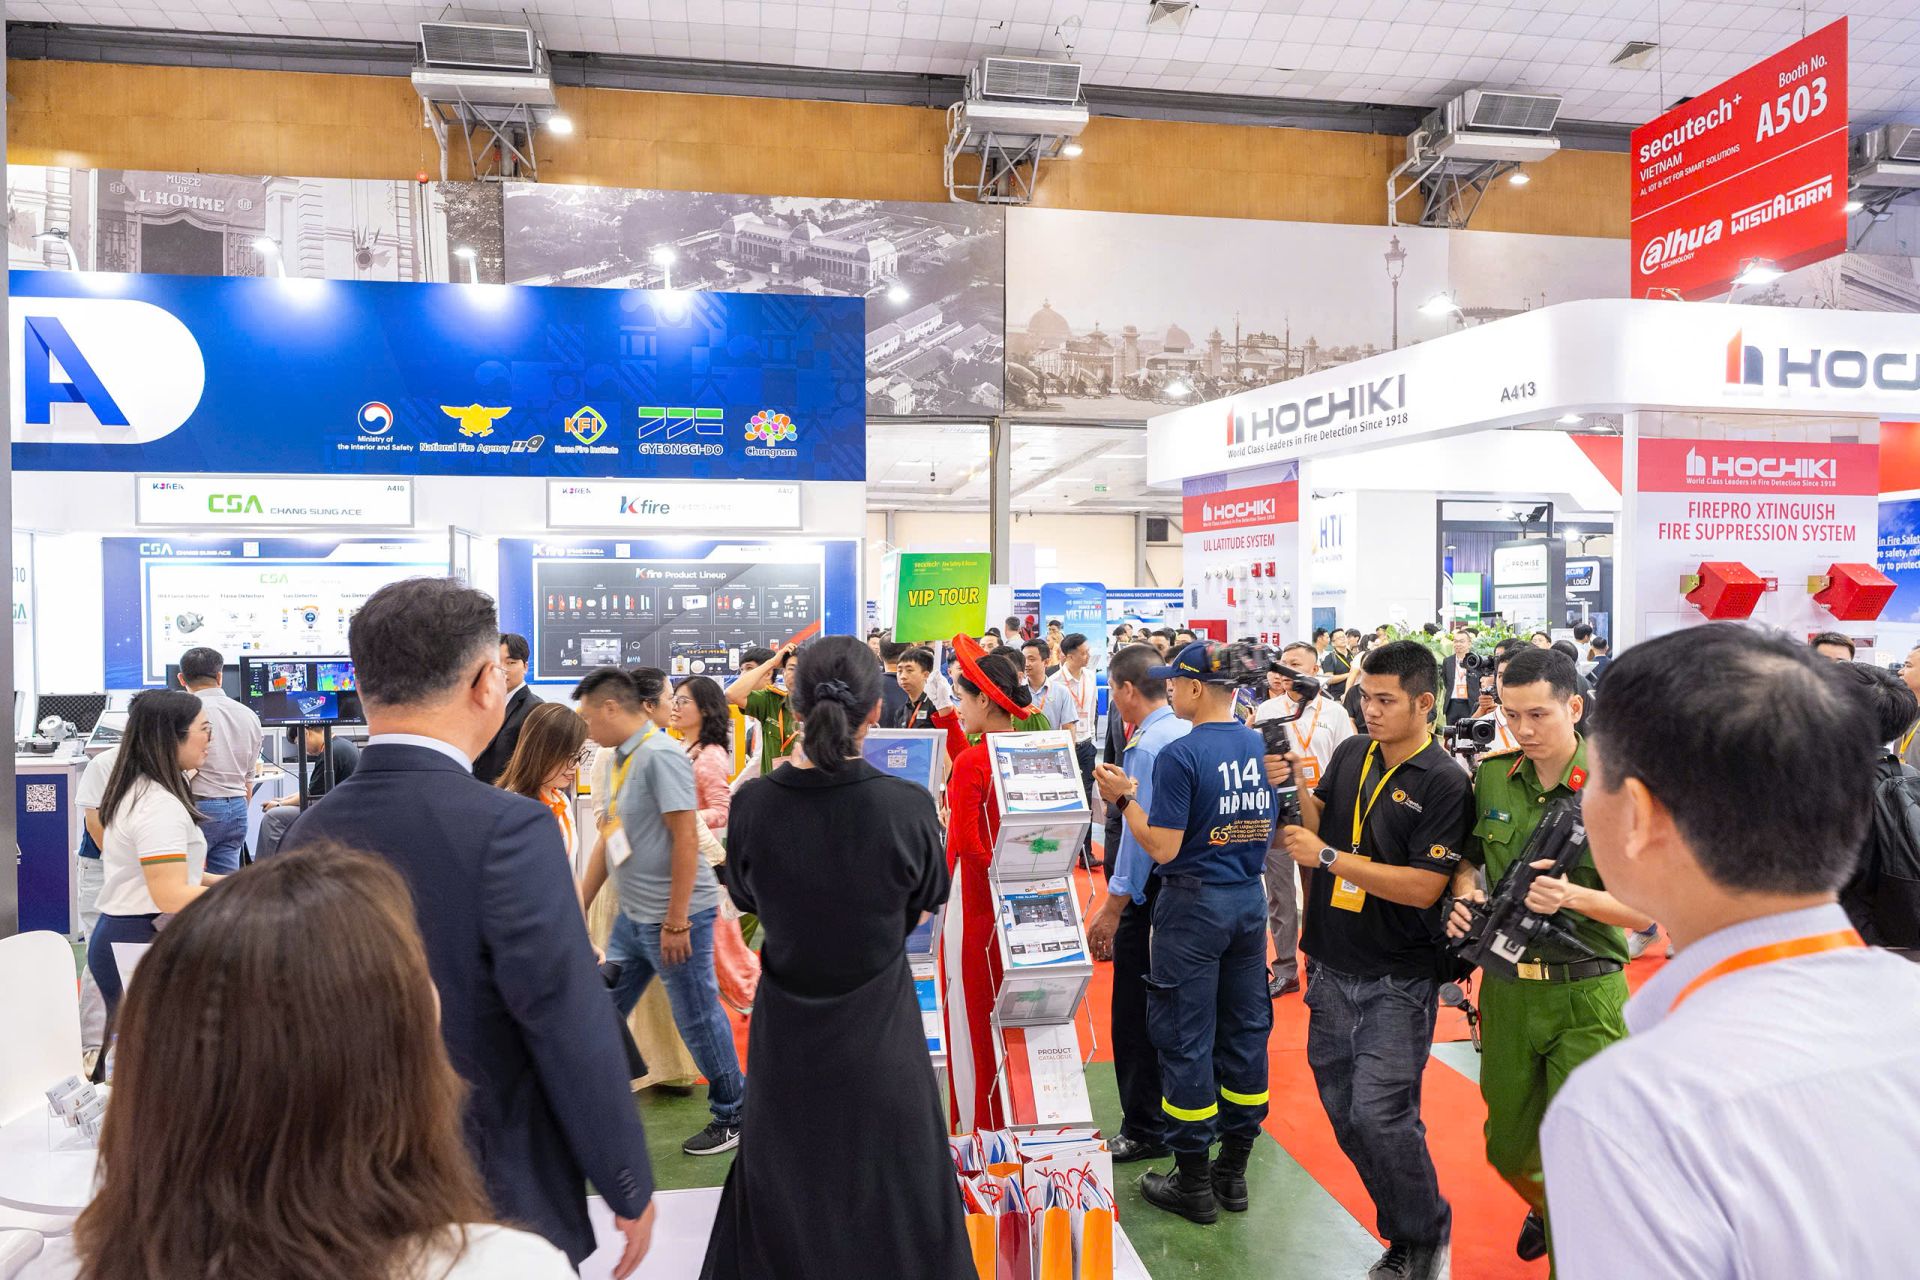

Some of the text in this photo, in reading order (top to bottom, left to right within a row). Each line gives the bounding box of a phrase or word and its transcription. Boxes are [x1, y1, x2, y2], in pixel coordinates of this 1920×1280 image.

[1778, 54, 1828, 88] Booth No.
[1756, 76, 1828, 143] A503
[1640, 152, 1683, 182] VIETNAM
[1663, 176, 1672, 186] ICT
[1672, 170, 1684, 181] FOR
[1684, 160, 1705, 176] SMART
[1706, 144, 1740, 166] SOLUTIONS
[177, 186, 190, 194] DE
[1660, 252, 1695, 270] TECHNOLOGY
[1778, 348, 1920, 391] HOC
[1500, 381, 1537, 403] A413
[1252, 374, 1406, 441] HOCHIKI
[564, 417, 598, 433] KFI
[358, 436, 384, 444] Ministry
[1228, 412, 1408, 458] World Class Leaders in Fire Detection Since 1918
[392, 444, 414, 452] Safety
[420, 443, 510, 454] National Fire Agency
[554, 445, 618, 454] Korea Fire Institute
[639, 444, 724, 456] GYEONGGI-DO
[745, 447, 797, 458] Chungnam
[1712, 456, 1836, 479] HOCHIKI
[208, 494, 264, 514] CSA
[270, 507, 307, 515] CHANG
[1214, 498, 1275, 520] HOCHIKI
[1688, 502, 1835, 521] FIREPRO XTINGUISH
[1658, 522, 1856, 542] FIRE SUPPRESSION SYSTEM
[1888, 536, 1900, 545] Fire
[139, 543, 173, 555] CSA
[1203, 534, 1275, 552] UL LATITUDE SYSTEM
[699, 571, 727, 580] Lineup
[908, 587, 979, 607] VIP TOUR
[1084, 609, 1102, 620] NAM
[1218, 758, 1261, 790] 114
[1220, 788, 1270, 815] HÀ NỘI
[1210, 826, 1230, 841] 65
